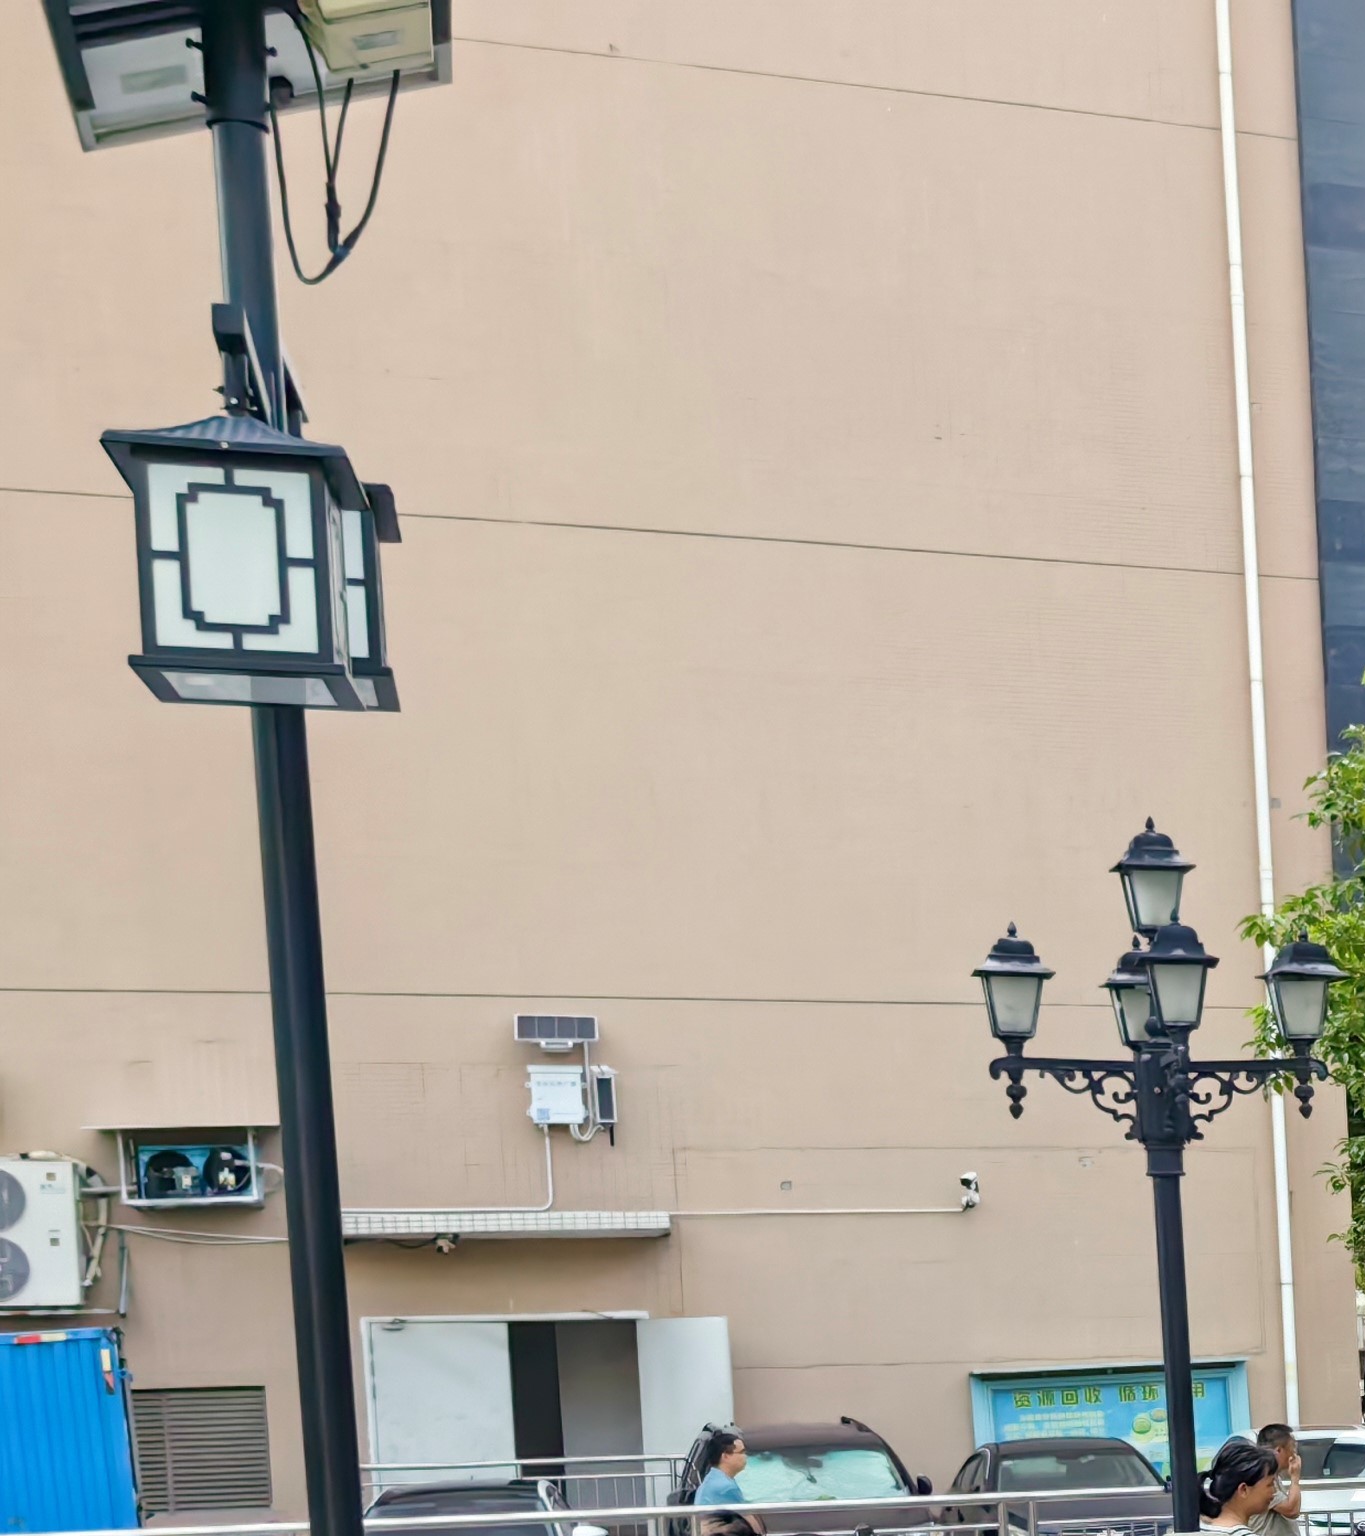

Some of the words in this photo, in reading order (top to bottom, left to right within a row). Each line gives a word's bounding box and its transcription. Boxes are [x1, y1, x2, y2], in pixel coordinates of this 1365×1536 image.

[1013, 1386, 1102, 1409] 资源回收
[1118, 1382, 1206, 1403] 循环用
